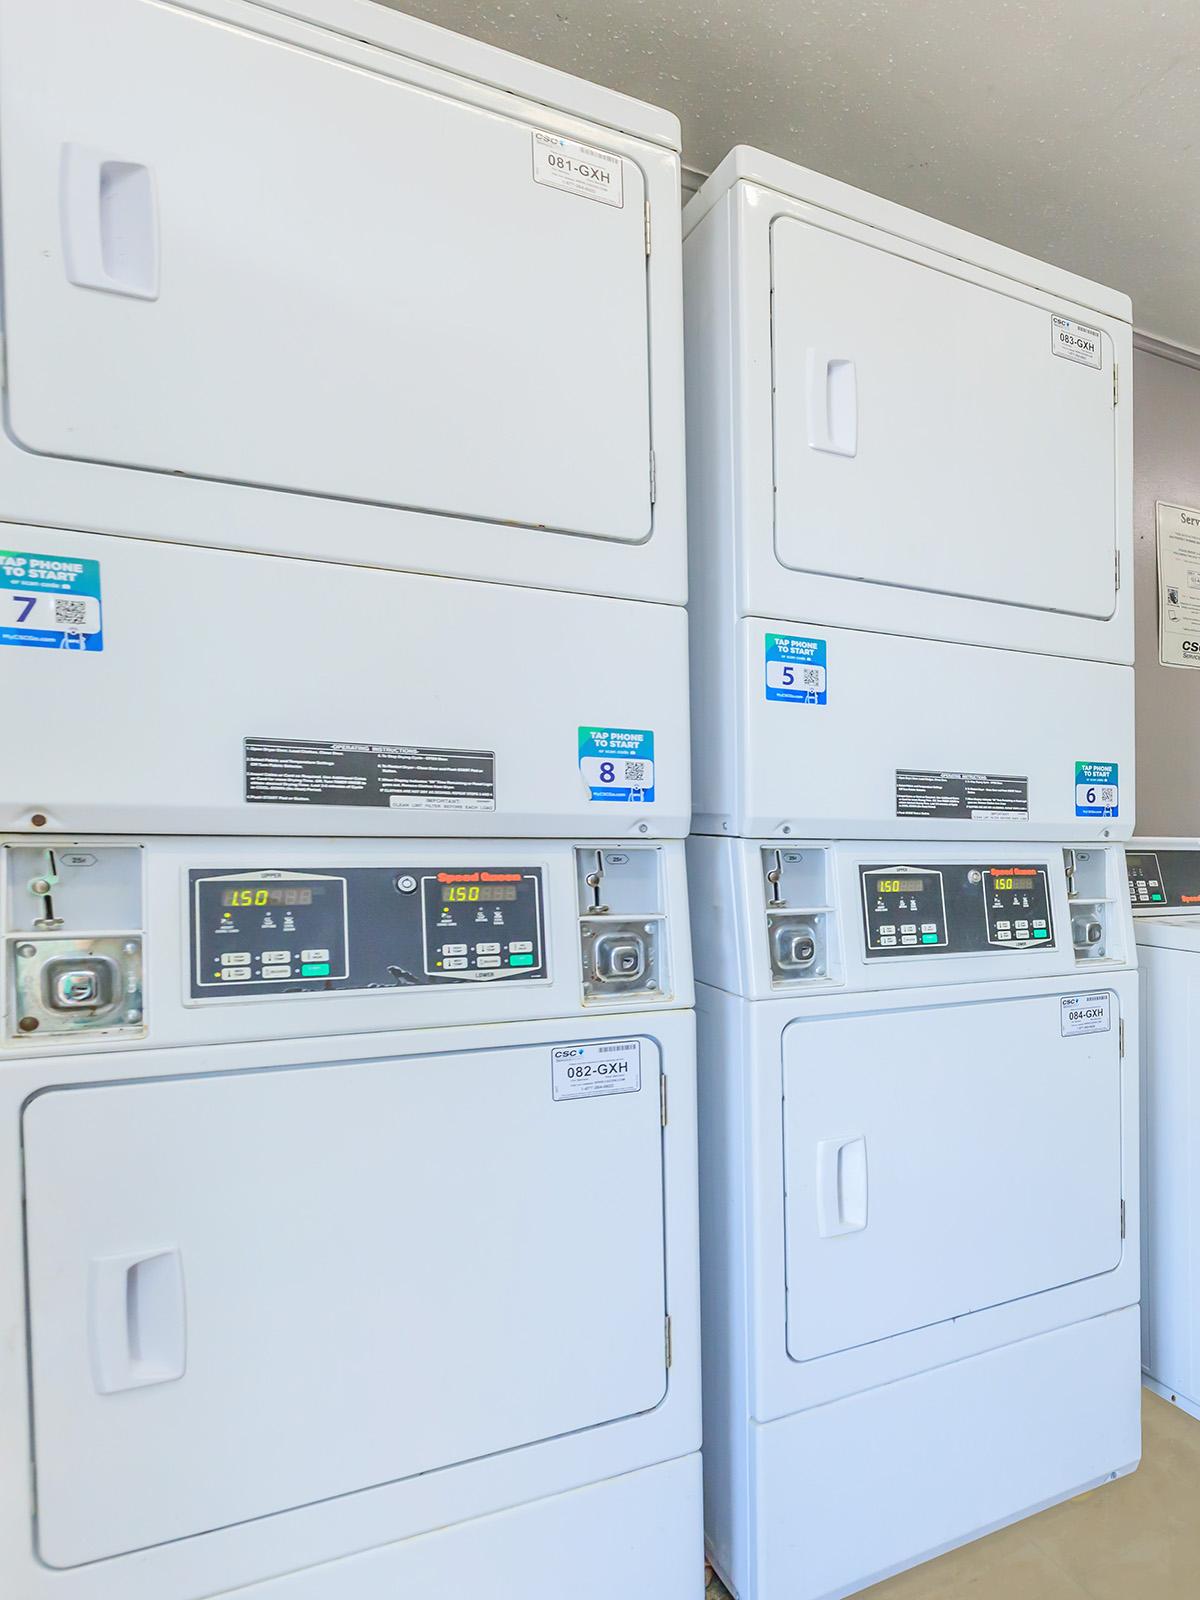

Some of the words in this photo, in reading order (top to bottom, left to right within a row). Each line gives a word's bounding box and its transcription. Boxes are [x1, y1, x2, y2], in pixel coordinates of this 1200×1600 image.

[547, 154, 611, 184] 081-GXH
[1059, 332, 1095, 352] 083-GXH
[3, 566, 26, 577] TO
[28, 569, 78, 582] START
[29, 559, 84, 574] PHONE
[13, 595, 38, 623] 7
[774, 638, 790, 646] TAP
[791, 639, 818, 650] PHONE
[777, 645, 790, 653] TO
[790, 647, 815, 656] START
[782, 666, 795, 686] 5
[590, 731, 610, 740] TAP
[610, 733, 644, 742] PHONE
[594, 739, 608, 748] TO
[609, 740, 640, 749] START
[599, 761, 616, 784] 8
[1086, 787, 1096, 804] 6
[475, 971, 494, 979] LOWER
[1062, 998, 1076, 1006] CSC
[1069, 1008, 1104, 1021] 084-GXH
[554, 1049, 578, 1059] CSC
[566, 1061, 629, 1079] 082-GXH
